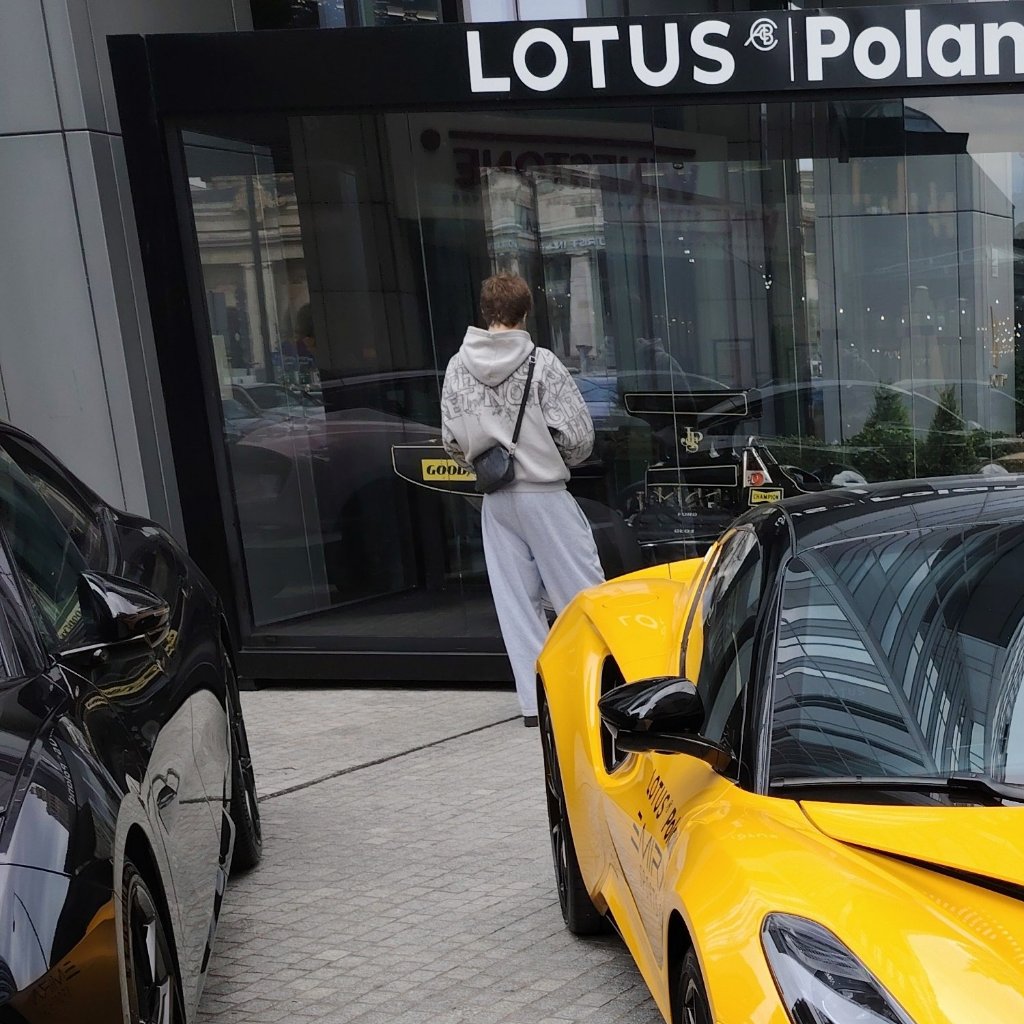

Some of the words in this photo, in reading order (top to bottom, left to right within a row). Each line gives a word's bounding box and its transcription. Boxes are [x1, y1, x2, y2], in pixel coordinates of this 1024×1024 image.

[466, 20, 735, 93] LOTUS
[752, 493, 779, 501] CHAMPION
[646, 769, 670, 819] LOTUS
